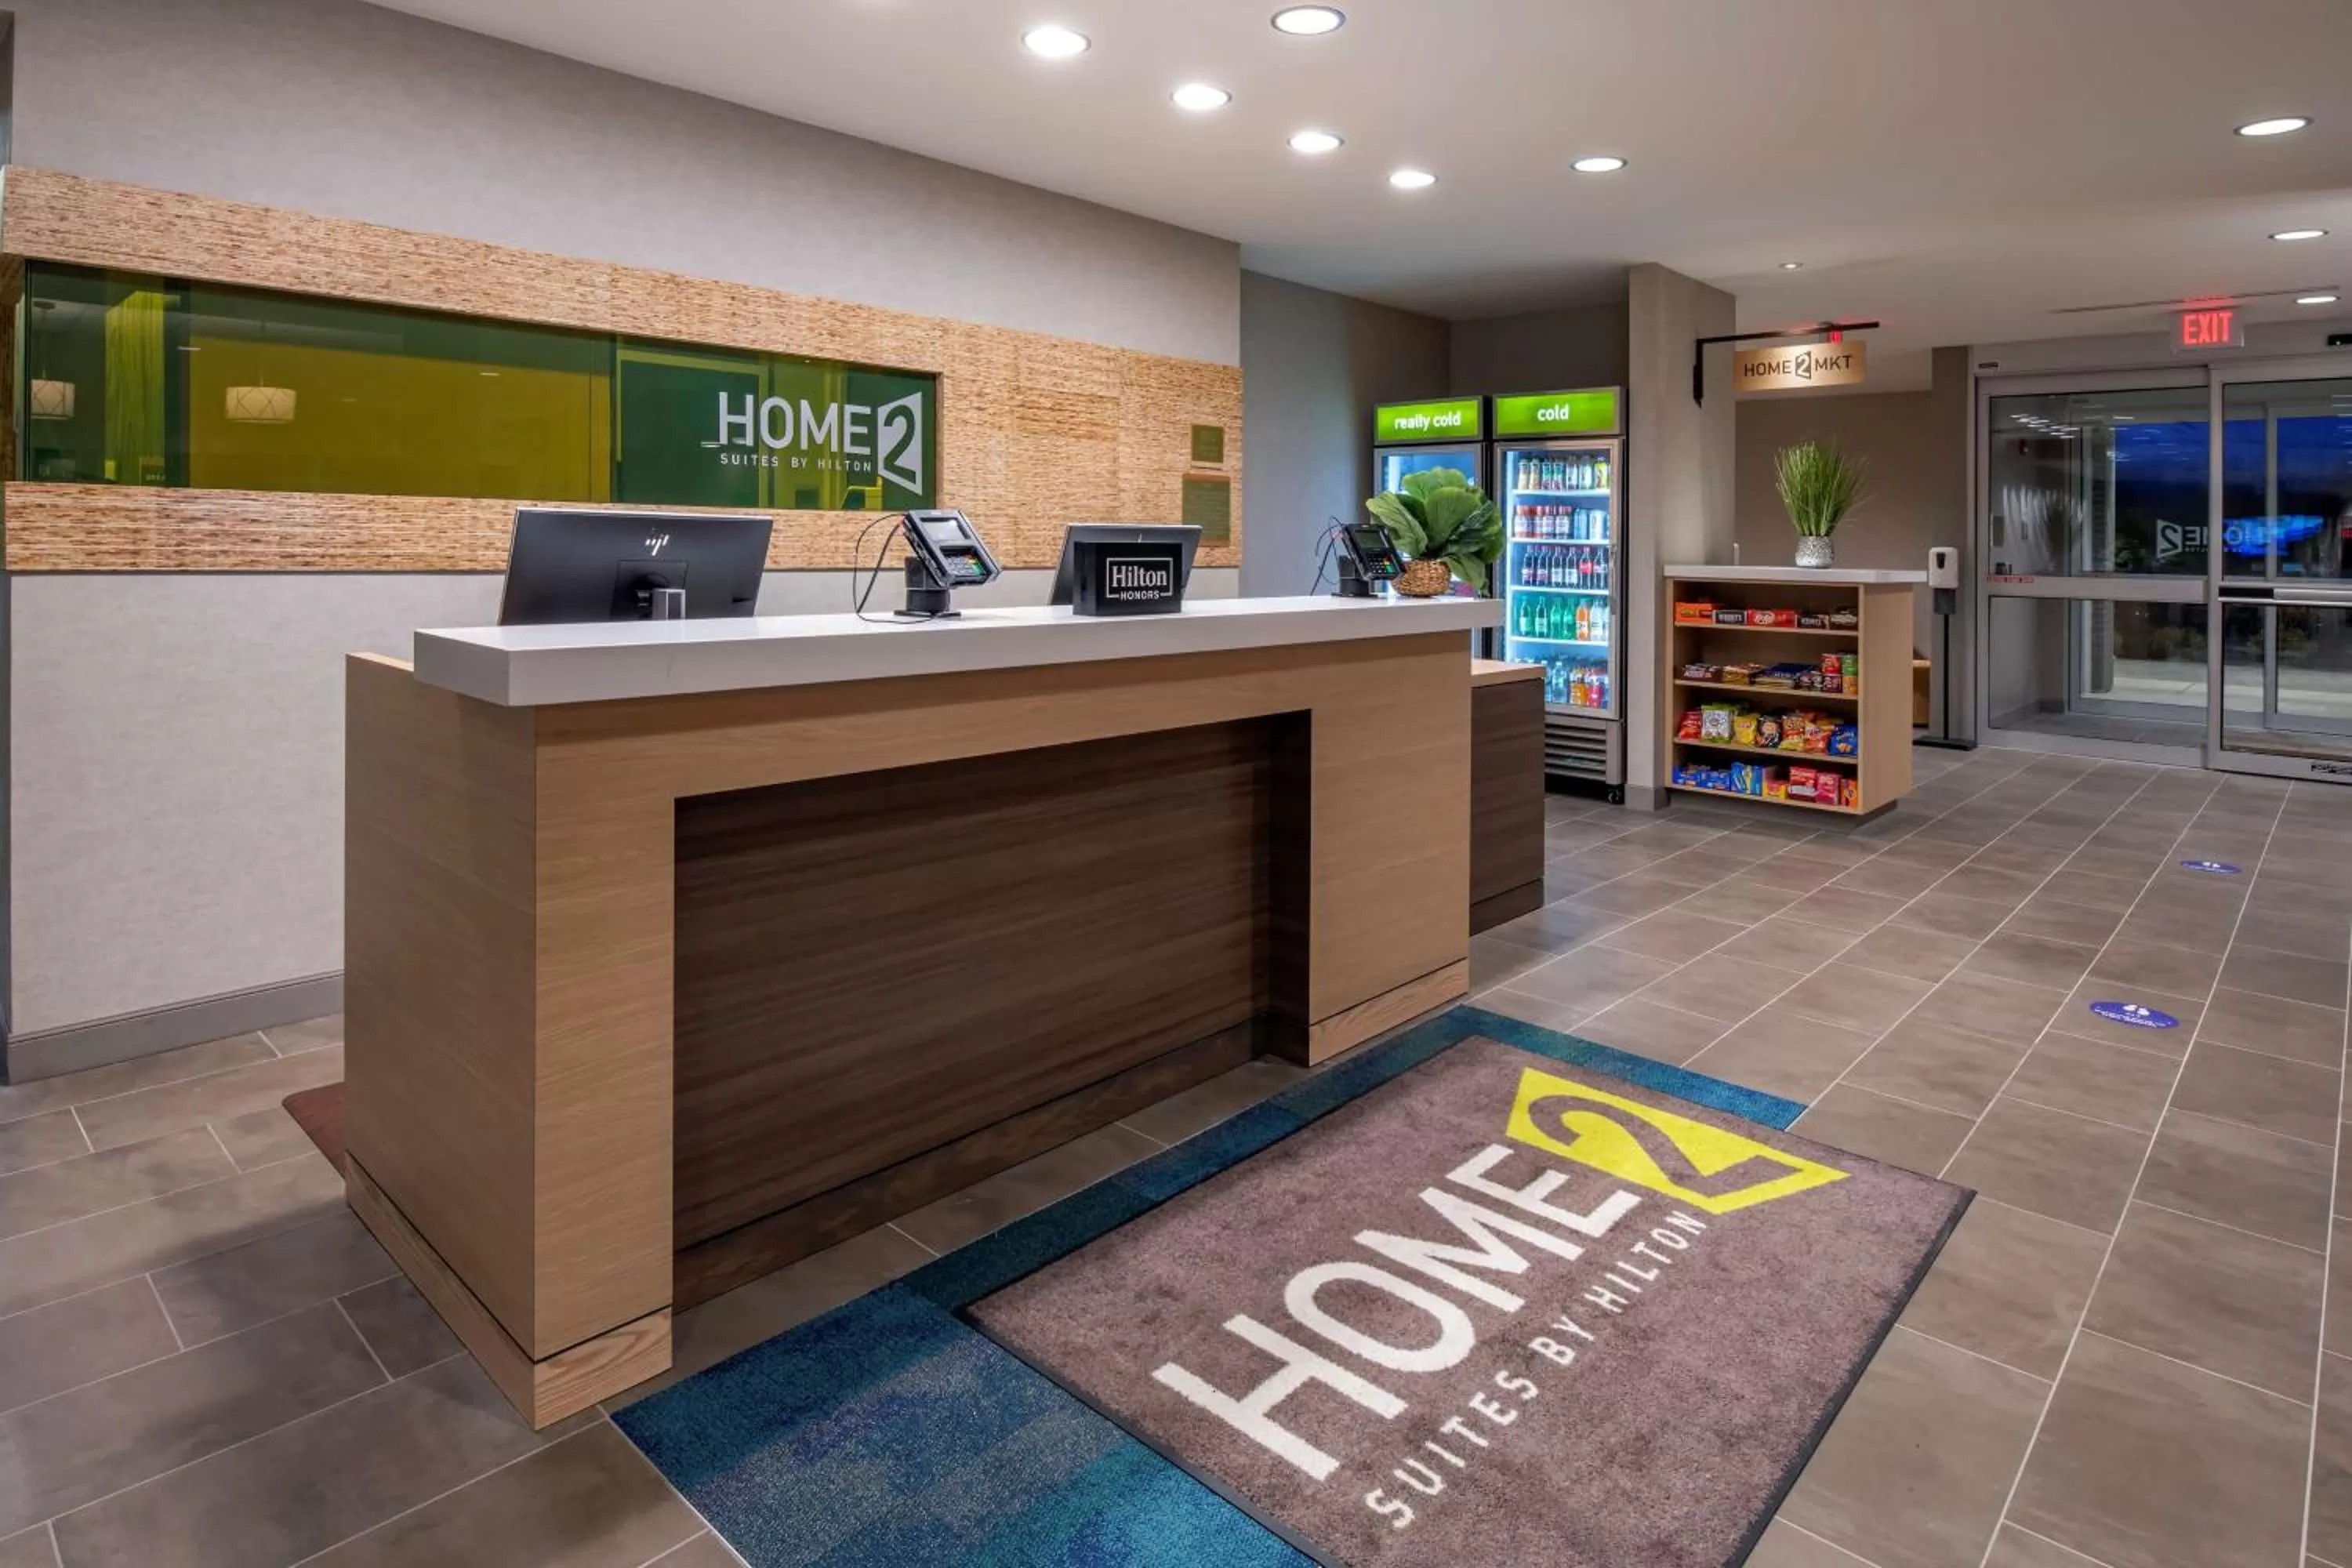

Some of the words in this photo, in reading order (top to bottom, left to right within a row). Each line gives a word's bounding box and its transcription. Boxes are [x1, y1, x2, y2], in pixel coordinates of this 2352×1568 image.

[2183, 312, 2232, 345] EXIT
[1395, 413, 1430, 431] really
[1433, 412, 1461, 428] cold
[1537, 404, 1569, 422] cold
[720, 452, 779, 467] SUITES
[791, 457, 808, 469] BY
[818, 459, 871, 472] HILTON
[1112, 565, 1167, 588] Hilton
[1120, 590, 1160, 601] HONORS
[1363, 1370, 1540, 1529] SUITES
[1527, 1314, 1595, 1367] BY
[1584, 1210, 1708, 1314] HILTON
